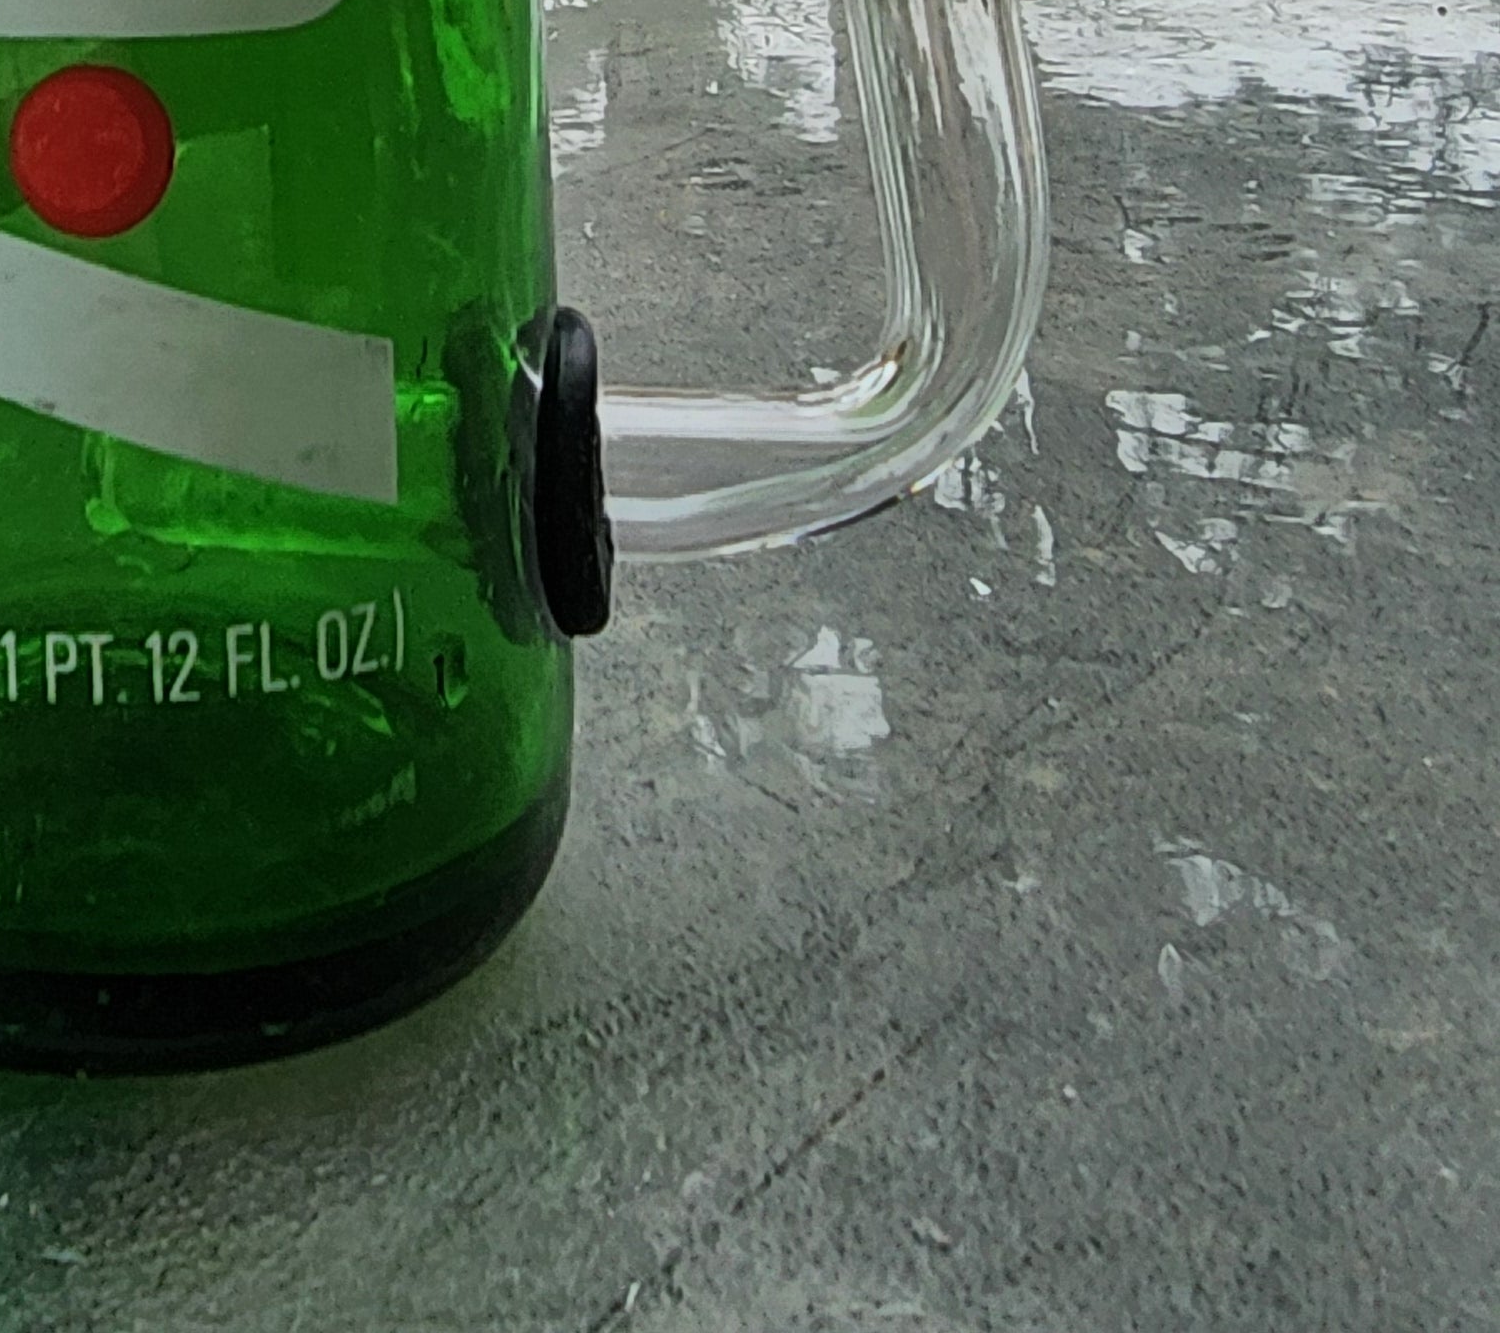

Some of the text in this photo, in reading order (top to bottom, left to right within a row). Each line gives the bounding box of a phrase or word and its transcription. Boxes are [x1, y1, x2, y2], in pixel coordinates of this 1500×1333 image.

[45, 631, 128, 706] PT.
[145, 630, 200, 705] 12
[226, 620, 300, 699] FL.
[317, 585, 405, 679] OZ.)
